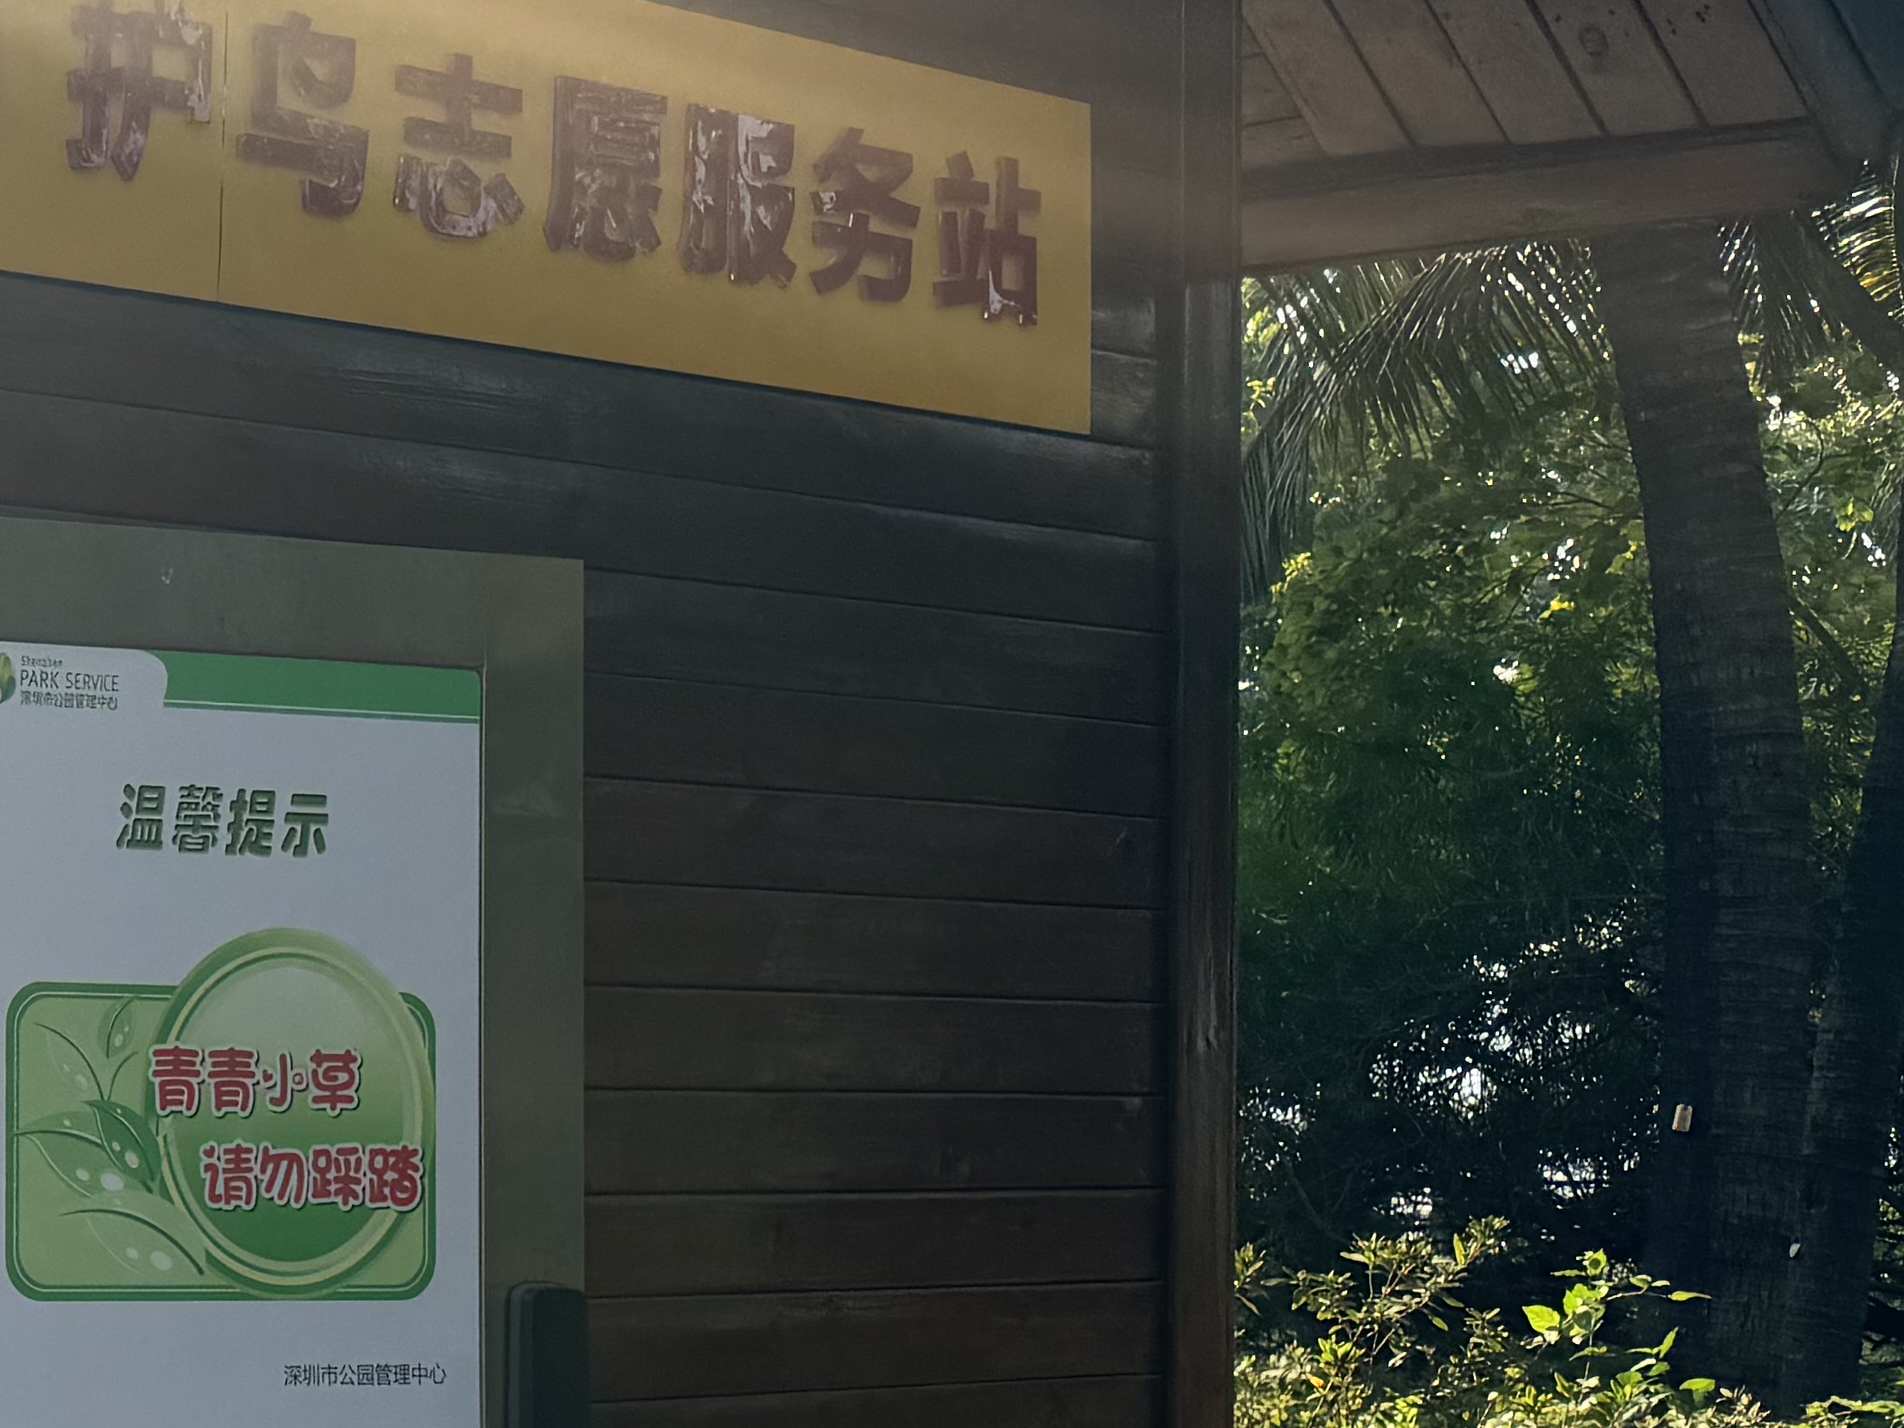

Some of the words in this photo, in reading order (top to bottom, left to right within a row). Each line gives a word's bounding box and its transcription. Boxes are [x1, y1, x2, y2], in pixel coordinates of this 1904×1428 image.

[20, 669, 59, 689] PARK
[65, 672, 119, 692] SERVICE
[115, 783, 330, 858] 温馨提示
[149, 1044, 362, 1115] 青青小草
[200, 1142, 424, 1212] 请勿踩踏
[283, 1362, 447, 1387] 深圳市公园管理中心
